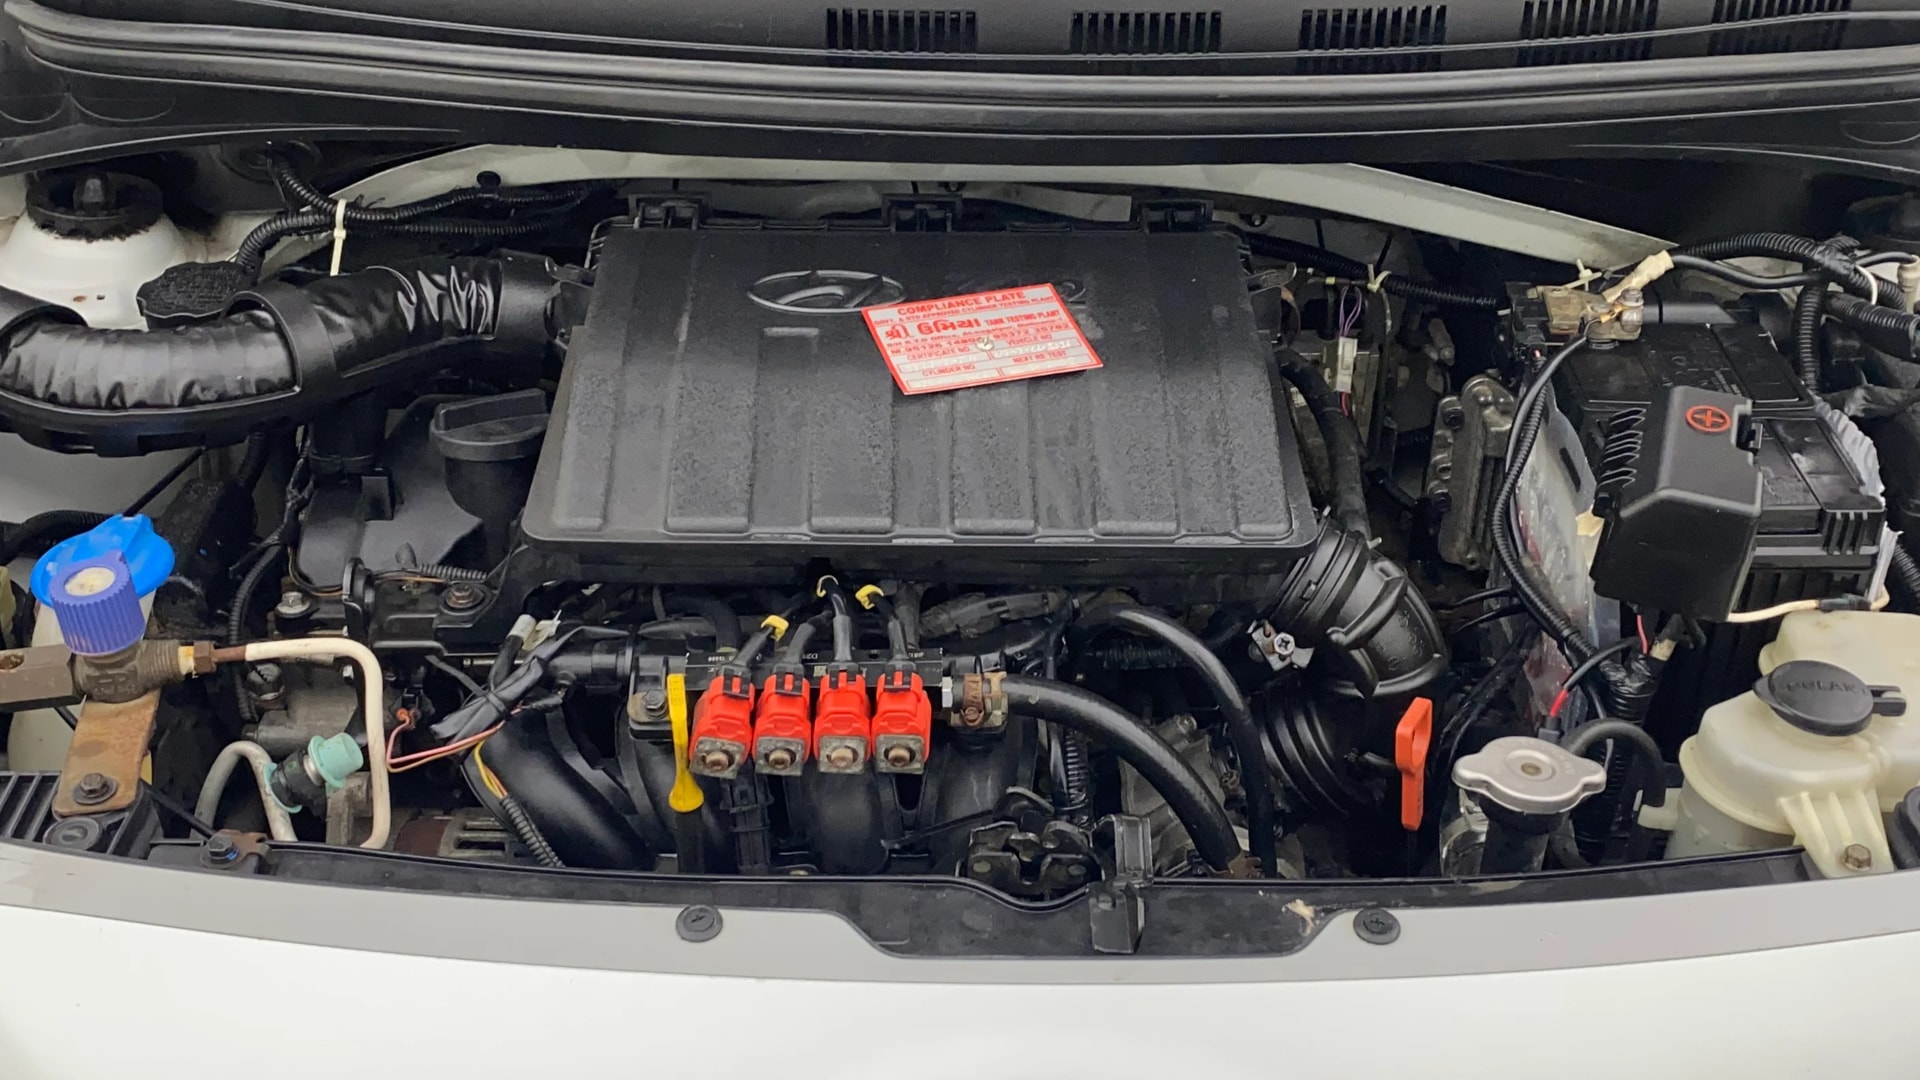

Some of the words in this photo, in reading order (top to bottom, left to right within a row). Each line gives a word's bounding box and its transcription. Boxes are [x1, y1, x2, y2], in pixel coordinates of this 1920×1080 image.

[898, 298, 981, 315] COMPLIANCE
[985, 292, 1025, 303] PLATE
[922, 310, 961, 318] APPROVED
[1006, 314, 1036, 322] TESTING
[1037, 310, 1061, 318] PLANT
[1007, 337, 1038, 345] VEHICLE
[907, 349, 955, 360] CERTIFICATE
[922, 367, 961, 376] CYLINDER
